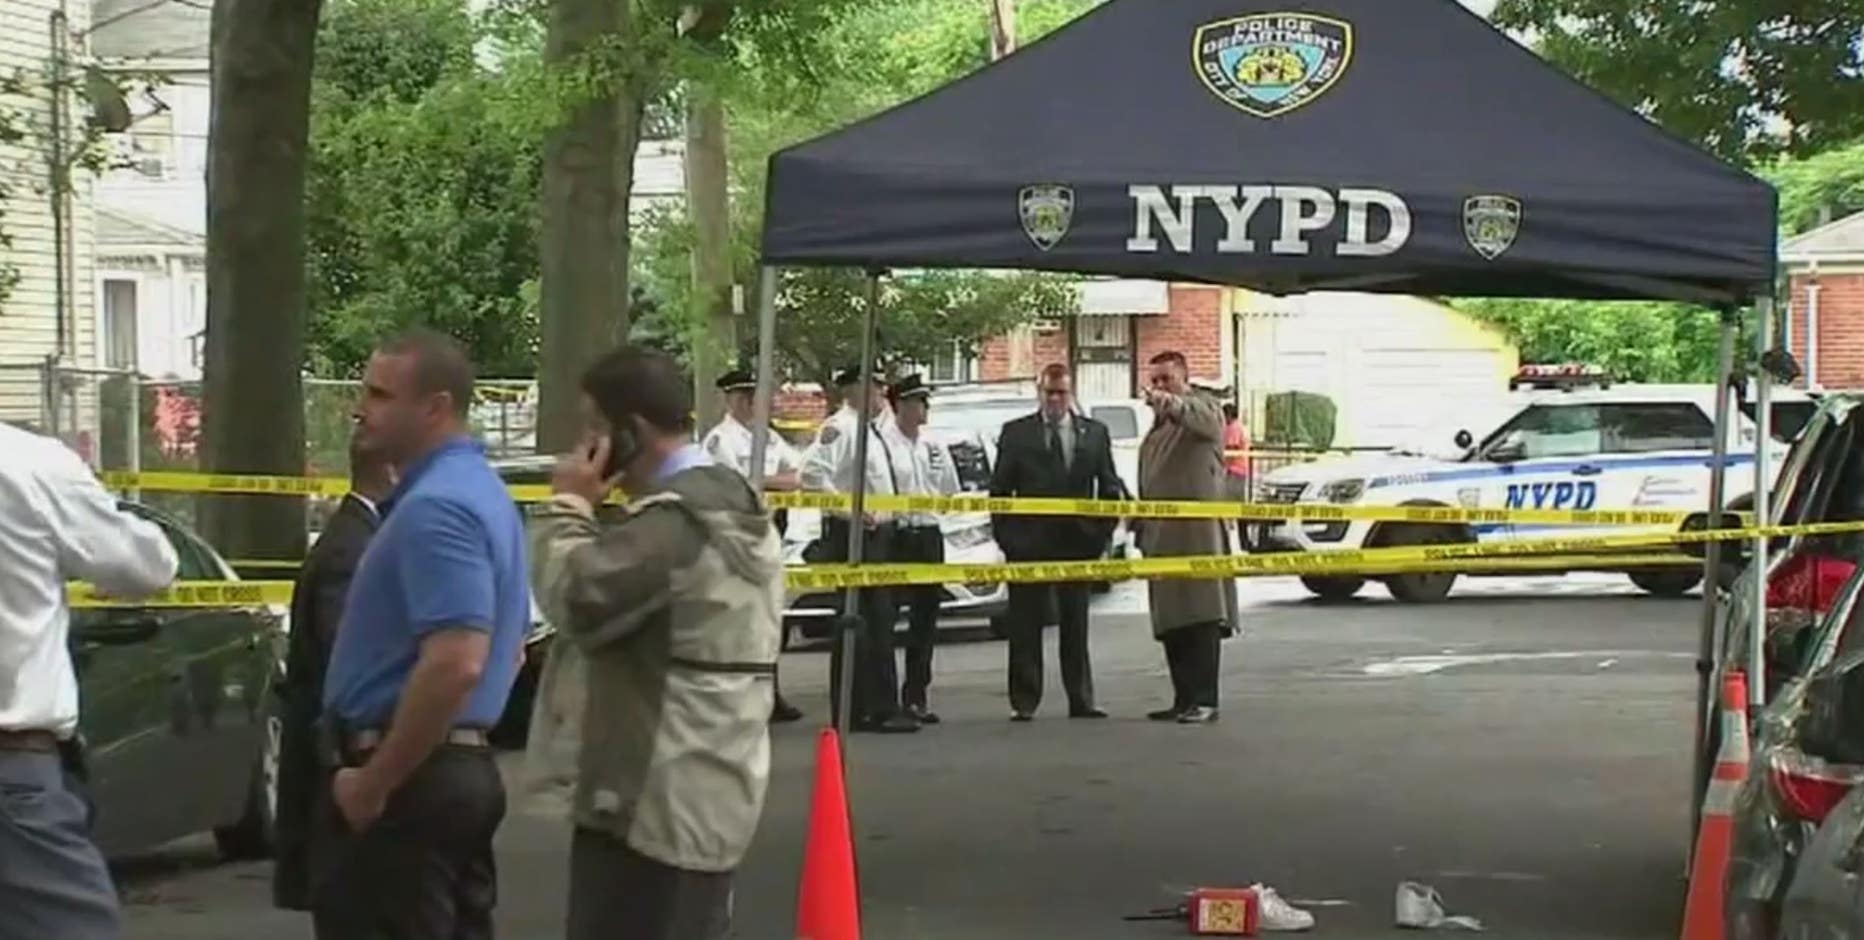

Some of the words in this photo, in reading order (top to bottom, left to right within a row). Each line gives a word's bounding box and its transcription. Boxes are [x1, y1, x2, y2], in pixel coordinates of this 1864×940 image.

[1234, 18, 1313, 35] POLICE
[1203, 30, 1341, 54] DEPARTMENT
[1126, 184, 1412, 256] NYPD
[1505, 481, 1596, 510] NYPD
